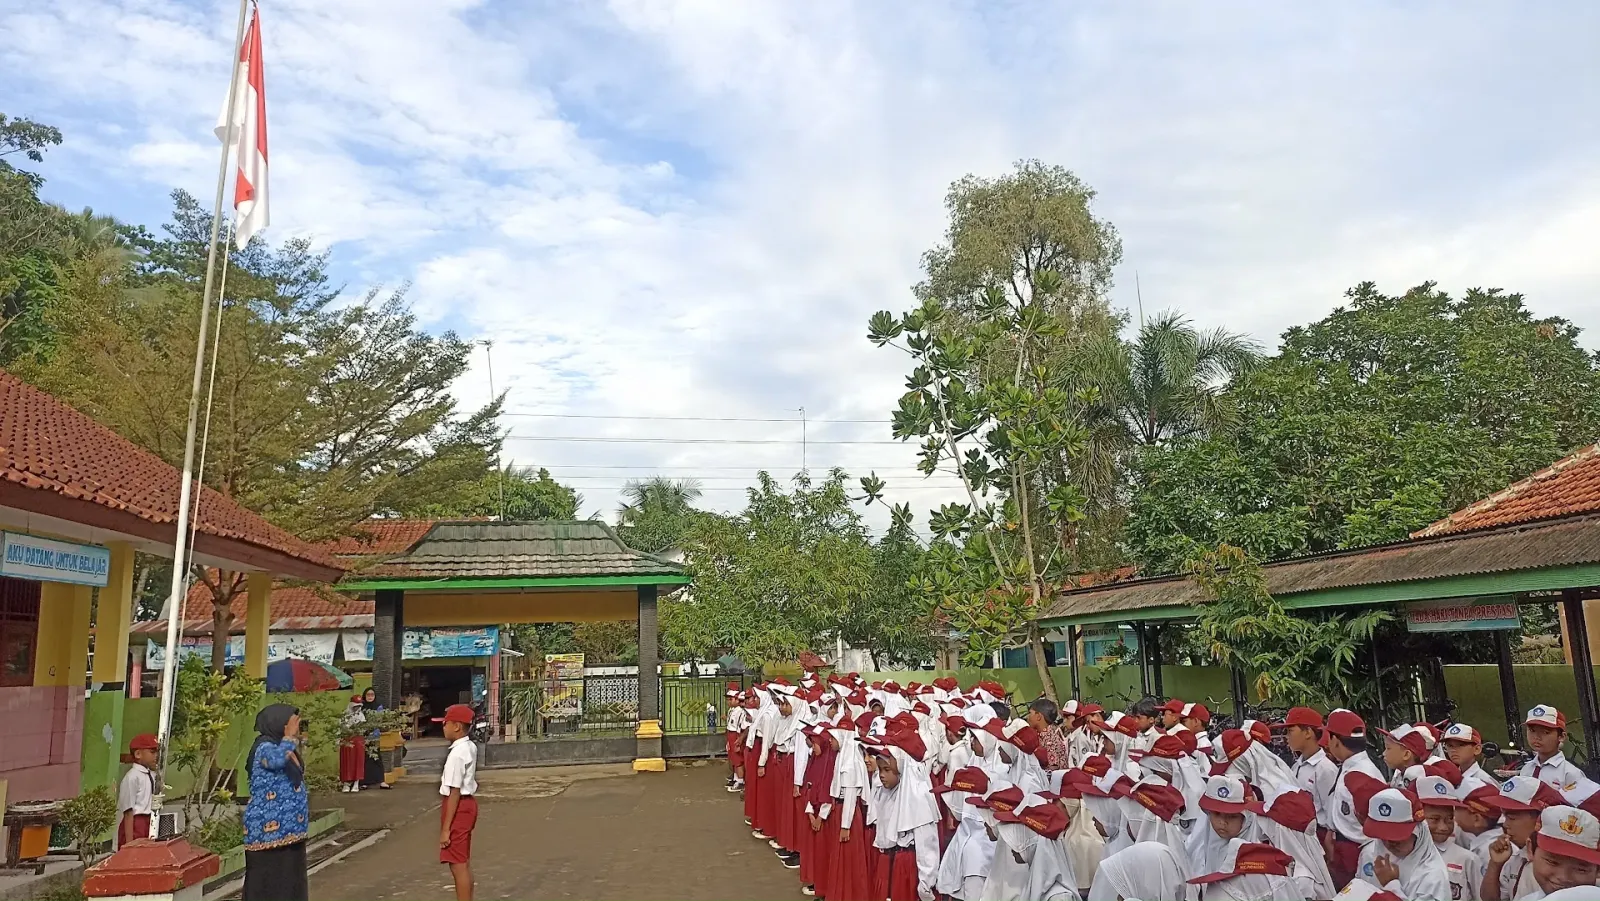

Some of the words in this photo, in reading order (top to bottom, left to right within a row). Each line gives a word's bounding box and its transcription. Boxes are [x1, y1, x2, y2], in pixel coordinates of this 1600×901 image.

[7, 544, 24, 562] AKU
[25, 547, 53, 566] DATANG
[56, 552, 78, 569] UNTUK
[79, 556, 106, 575] BELAJAR
[1449, 606, 1475, 621] TANPA
[1475, 604, 1515, 619] PRESTASI
